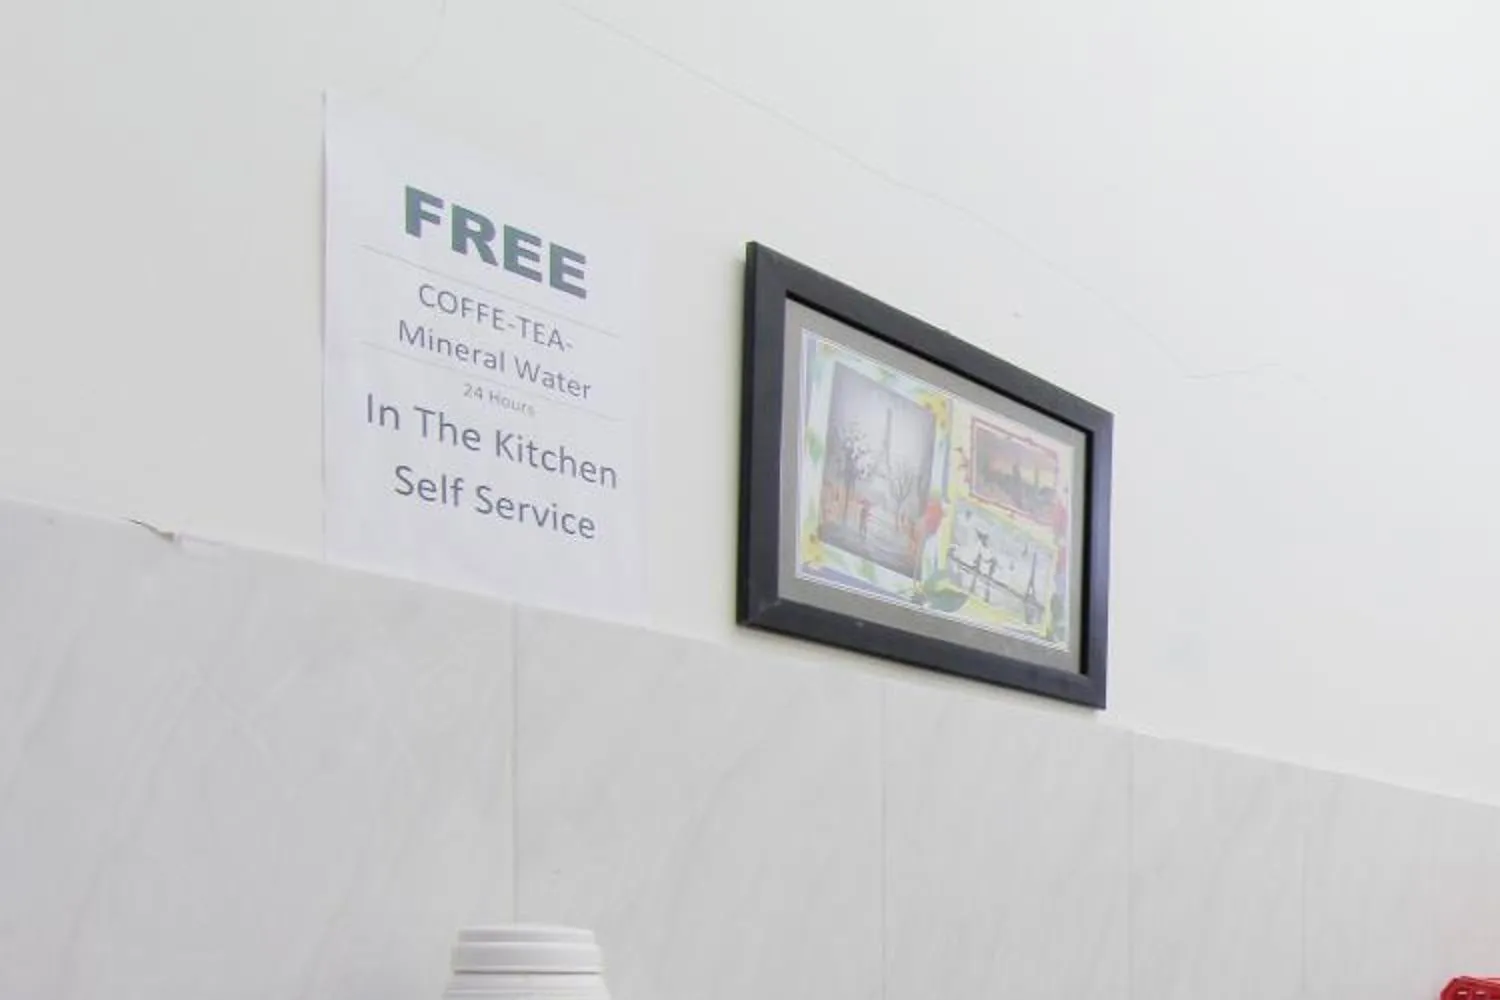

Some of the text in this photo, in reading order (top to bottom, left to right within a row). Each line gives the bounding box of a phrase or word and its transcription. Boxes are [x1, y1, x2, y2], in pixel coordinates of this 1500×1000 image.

[404, 183, 588, 300] FREE
[418, 282, 574, 353] COFFE-TEA-
[398, 318, 592, 400] Mineral Water
[463, 382, 536, 418] 24 Hours
[366, 392, 618, 490] In The Kitchen
[394, 464, 597, 541] Self Service
